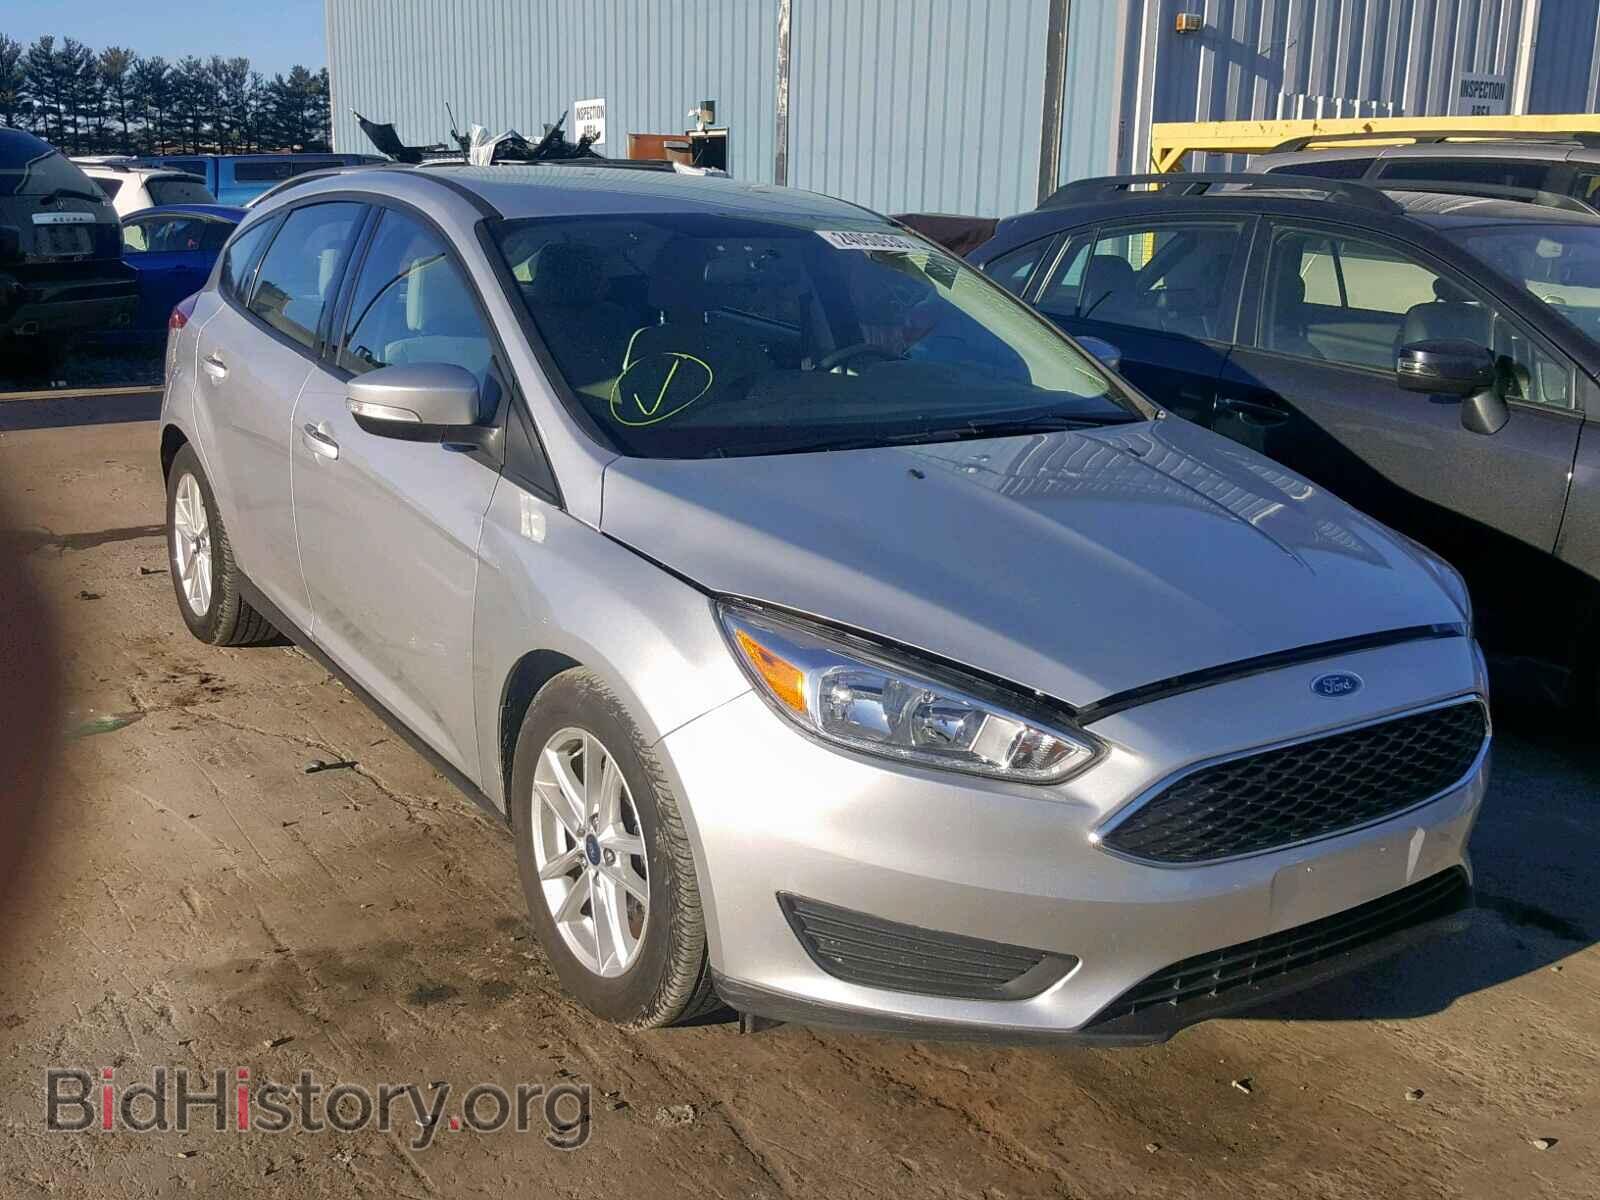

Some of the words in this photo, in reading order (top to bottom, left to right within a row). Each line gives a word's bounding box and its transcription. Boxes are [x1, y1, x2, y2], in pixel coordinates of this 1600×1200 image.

[1461, 80, 1505, 100] INSPECTION
[576, 105, 605, 120] INSPECTION
[1322, 677, 1353, 694] Ford
